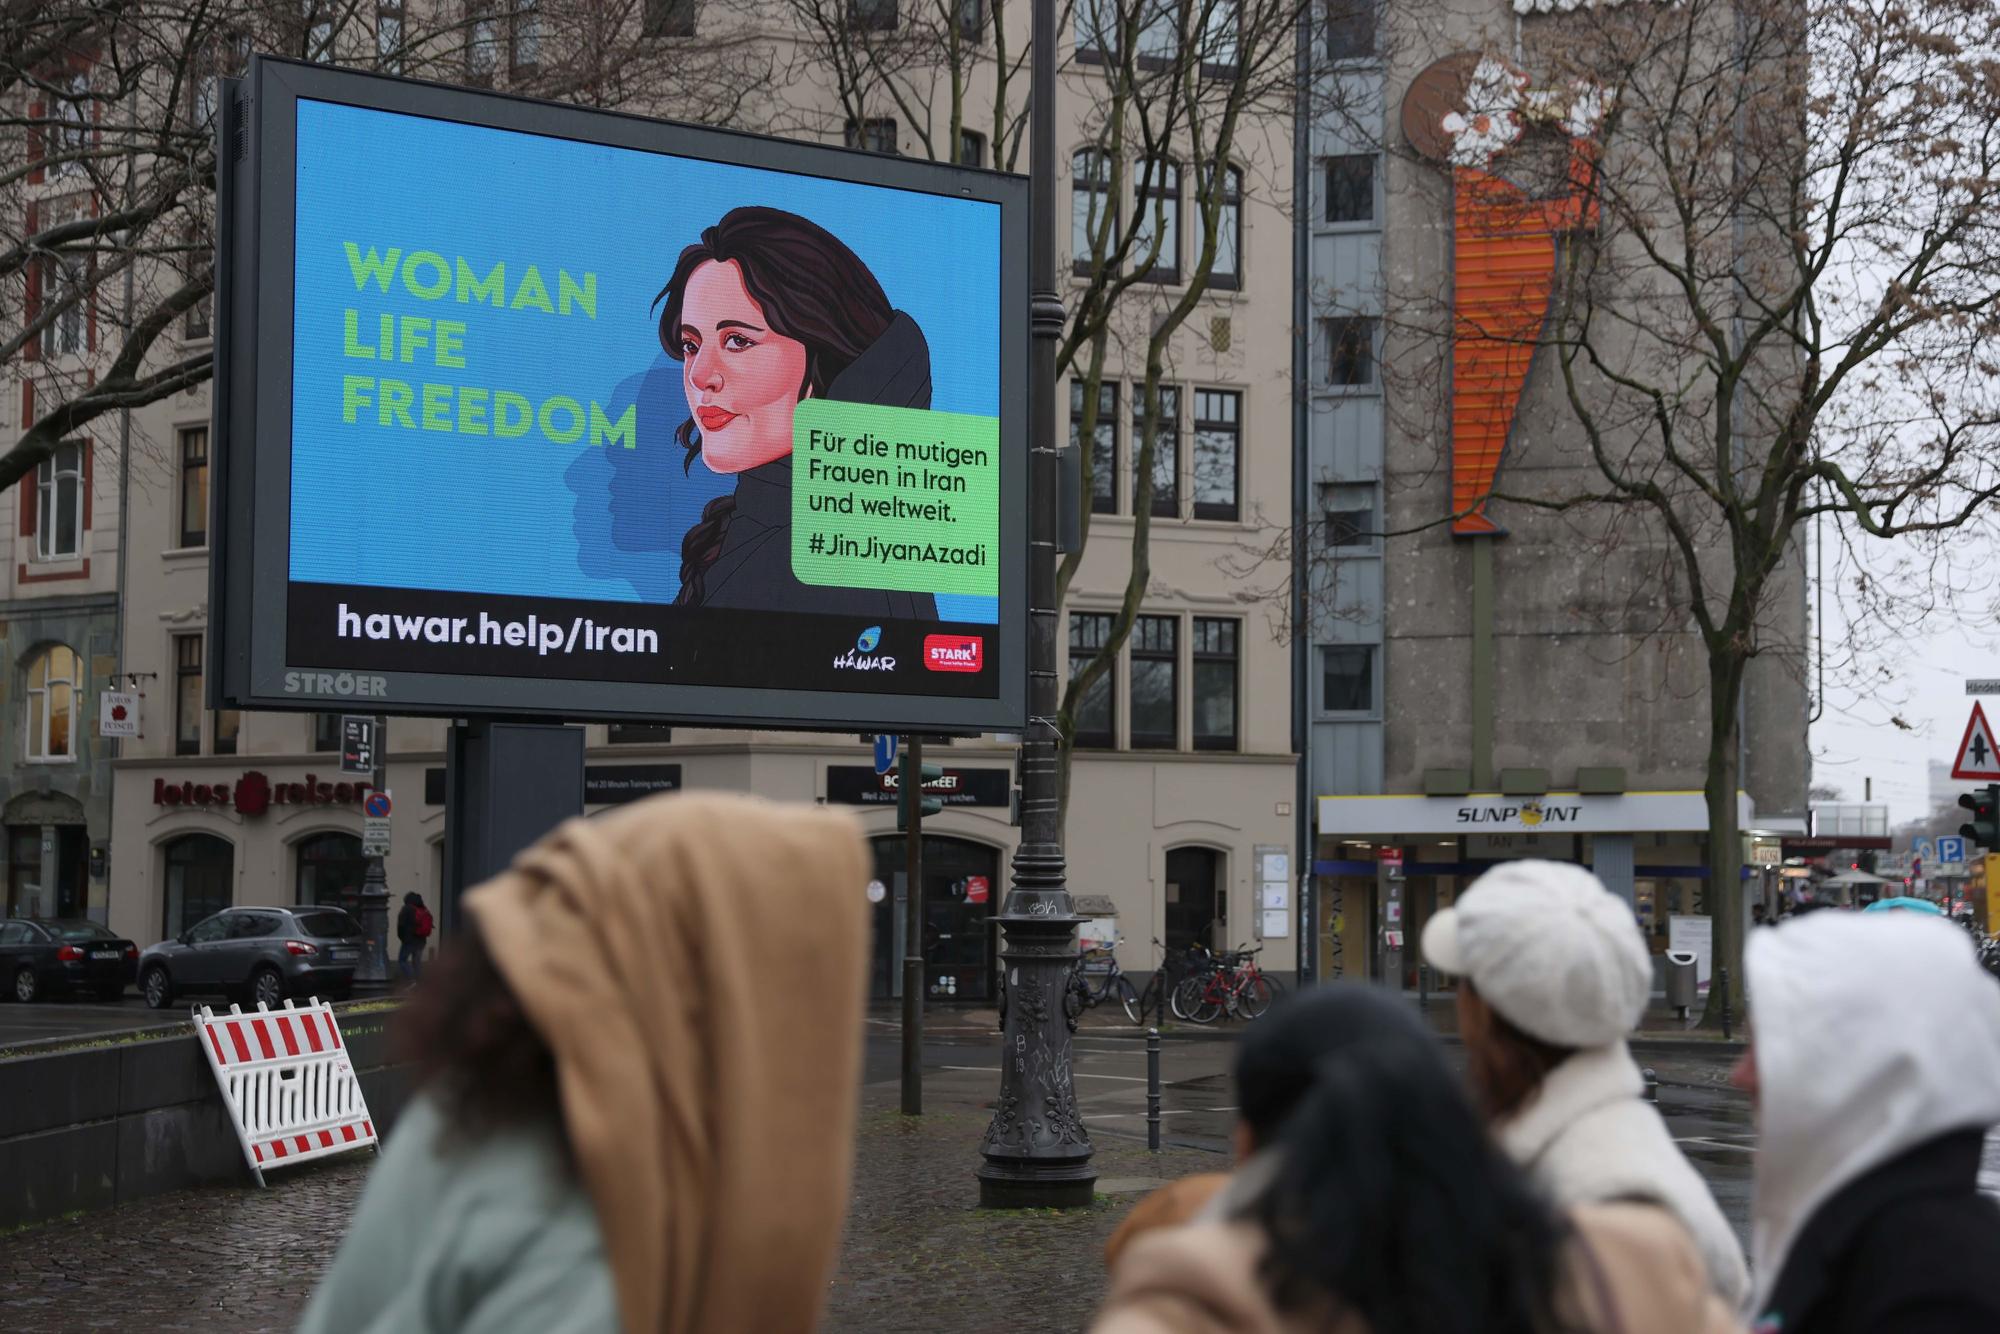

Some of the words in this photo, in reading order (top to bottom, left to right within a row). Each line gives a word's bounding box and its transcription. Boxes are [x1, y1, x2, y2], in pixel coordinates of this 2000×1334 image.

[343, 241, 597, 320] WOMAN
[344, 308, 466, 368] LIFE
[343, 375, 636, 449] FREEDOM
[809, 429, 847, 453] Für
[853, 433, 889, 457] die
[895, 441, 988, 468] mutigen
[809, 458, 889, 485] Frauen
[897, 465, 916, 488] in
[923, 469, 966, 493] Iran
[809, 492, 854, 514] und
[860, 496, 957, 522] weltweit.
[808, 533, 986, 566] #JinJiyanAzadi
[337, 603, 659, 656] hawar.help/iran
[284, 672, 388, 697] STRÖER
[153, 778, 230, 805] lotos
[1942, 840, 1958, 860] P
